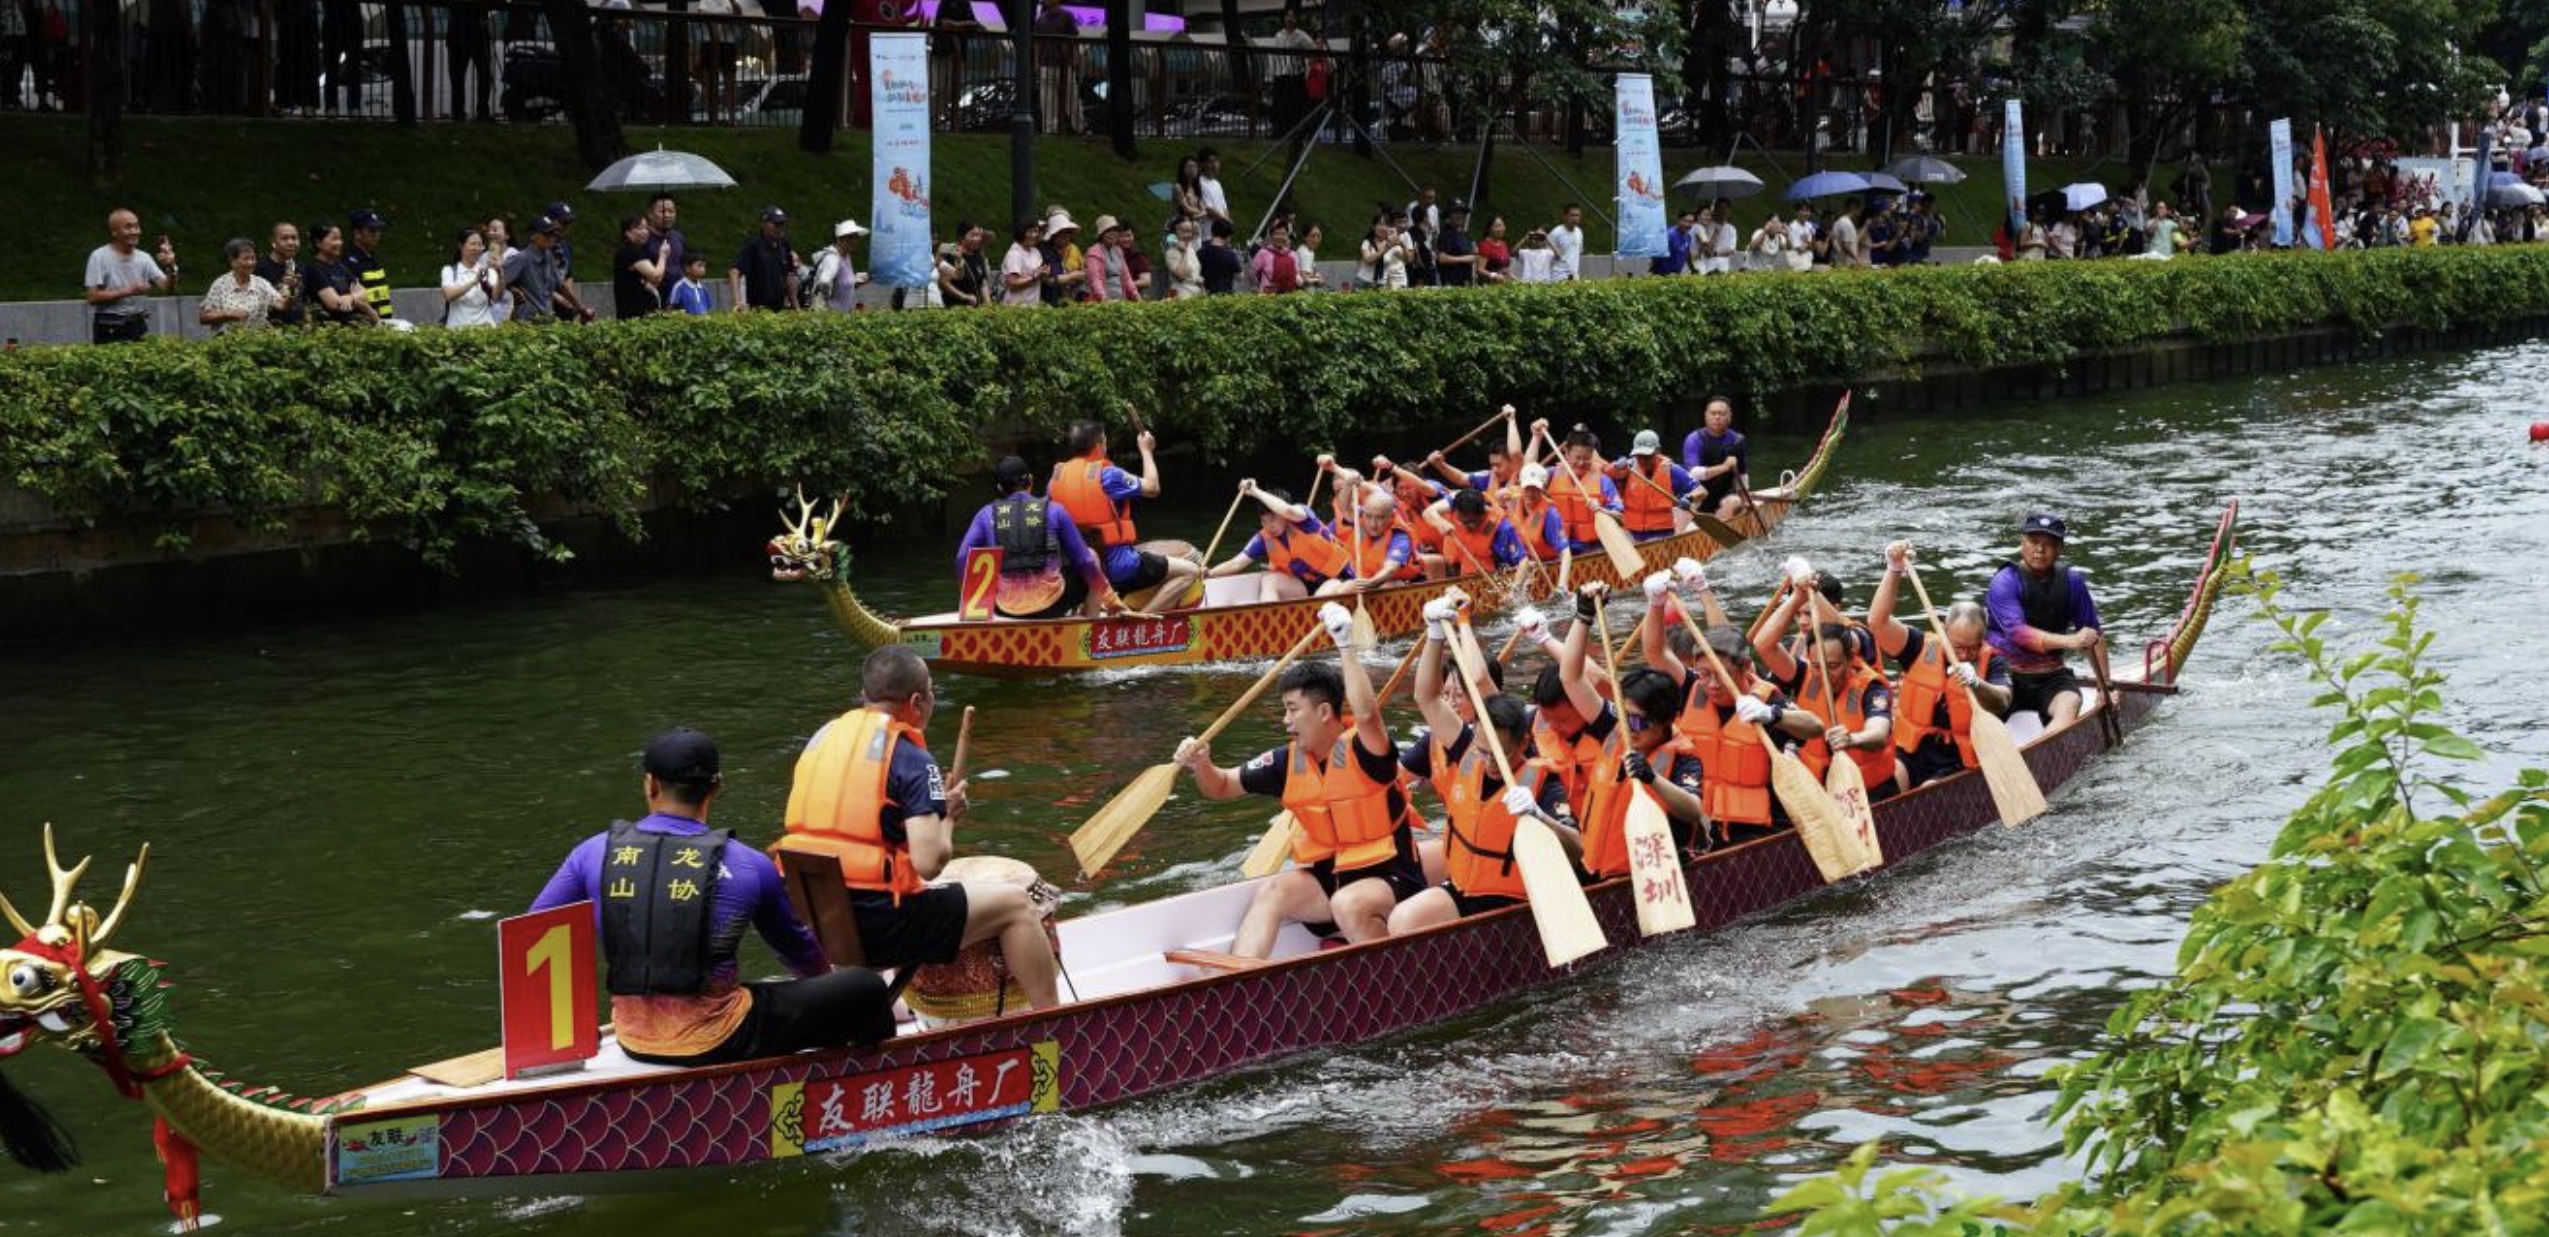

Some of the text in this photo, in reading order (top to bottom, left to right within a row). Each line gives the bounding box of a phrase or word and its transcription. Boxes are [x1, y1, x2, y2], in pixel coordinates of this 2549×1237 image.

[964, 552, 996, 620] 2
[1634, 832, 1683, 905] 深圳
[526, 923, 575, 1051] 1
[819, 1058, 1020, 1133] 友联龍舟厂
